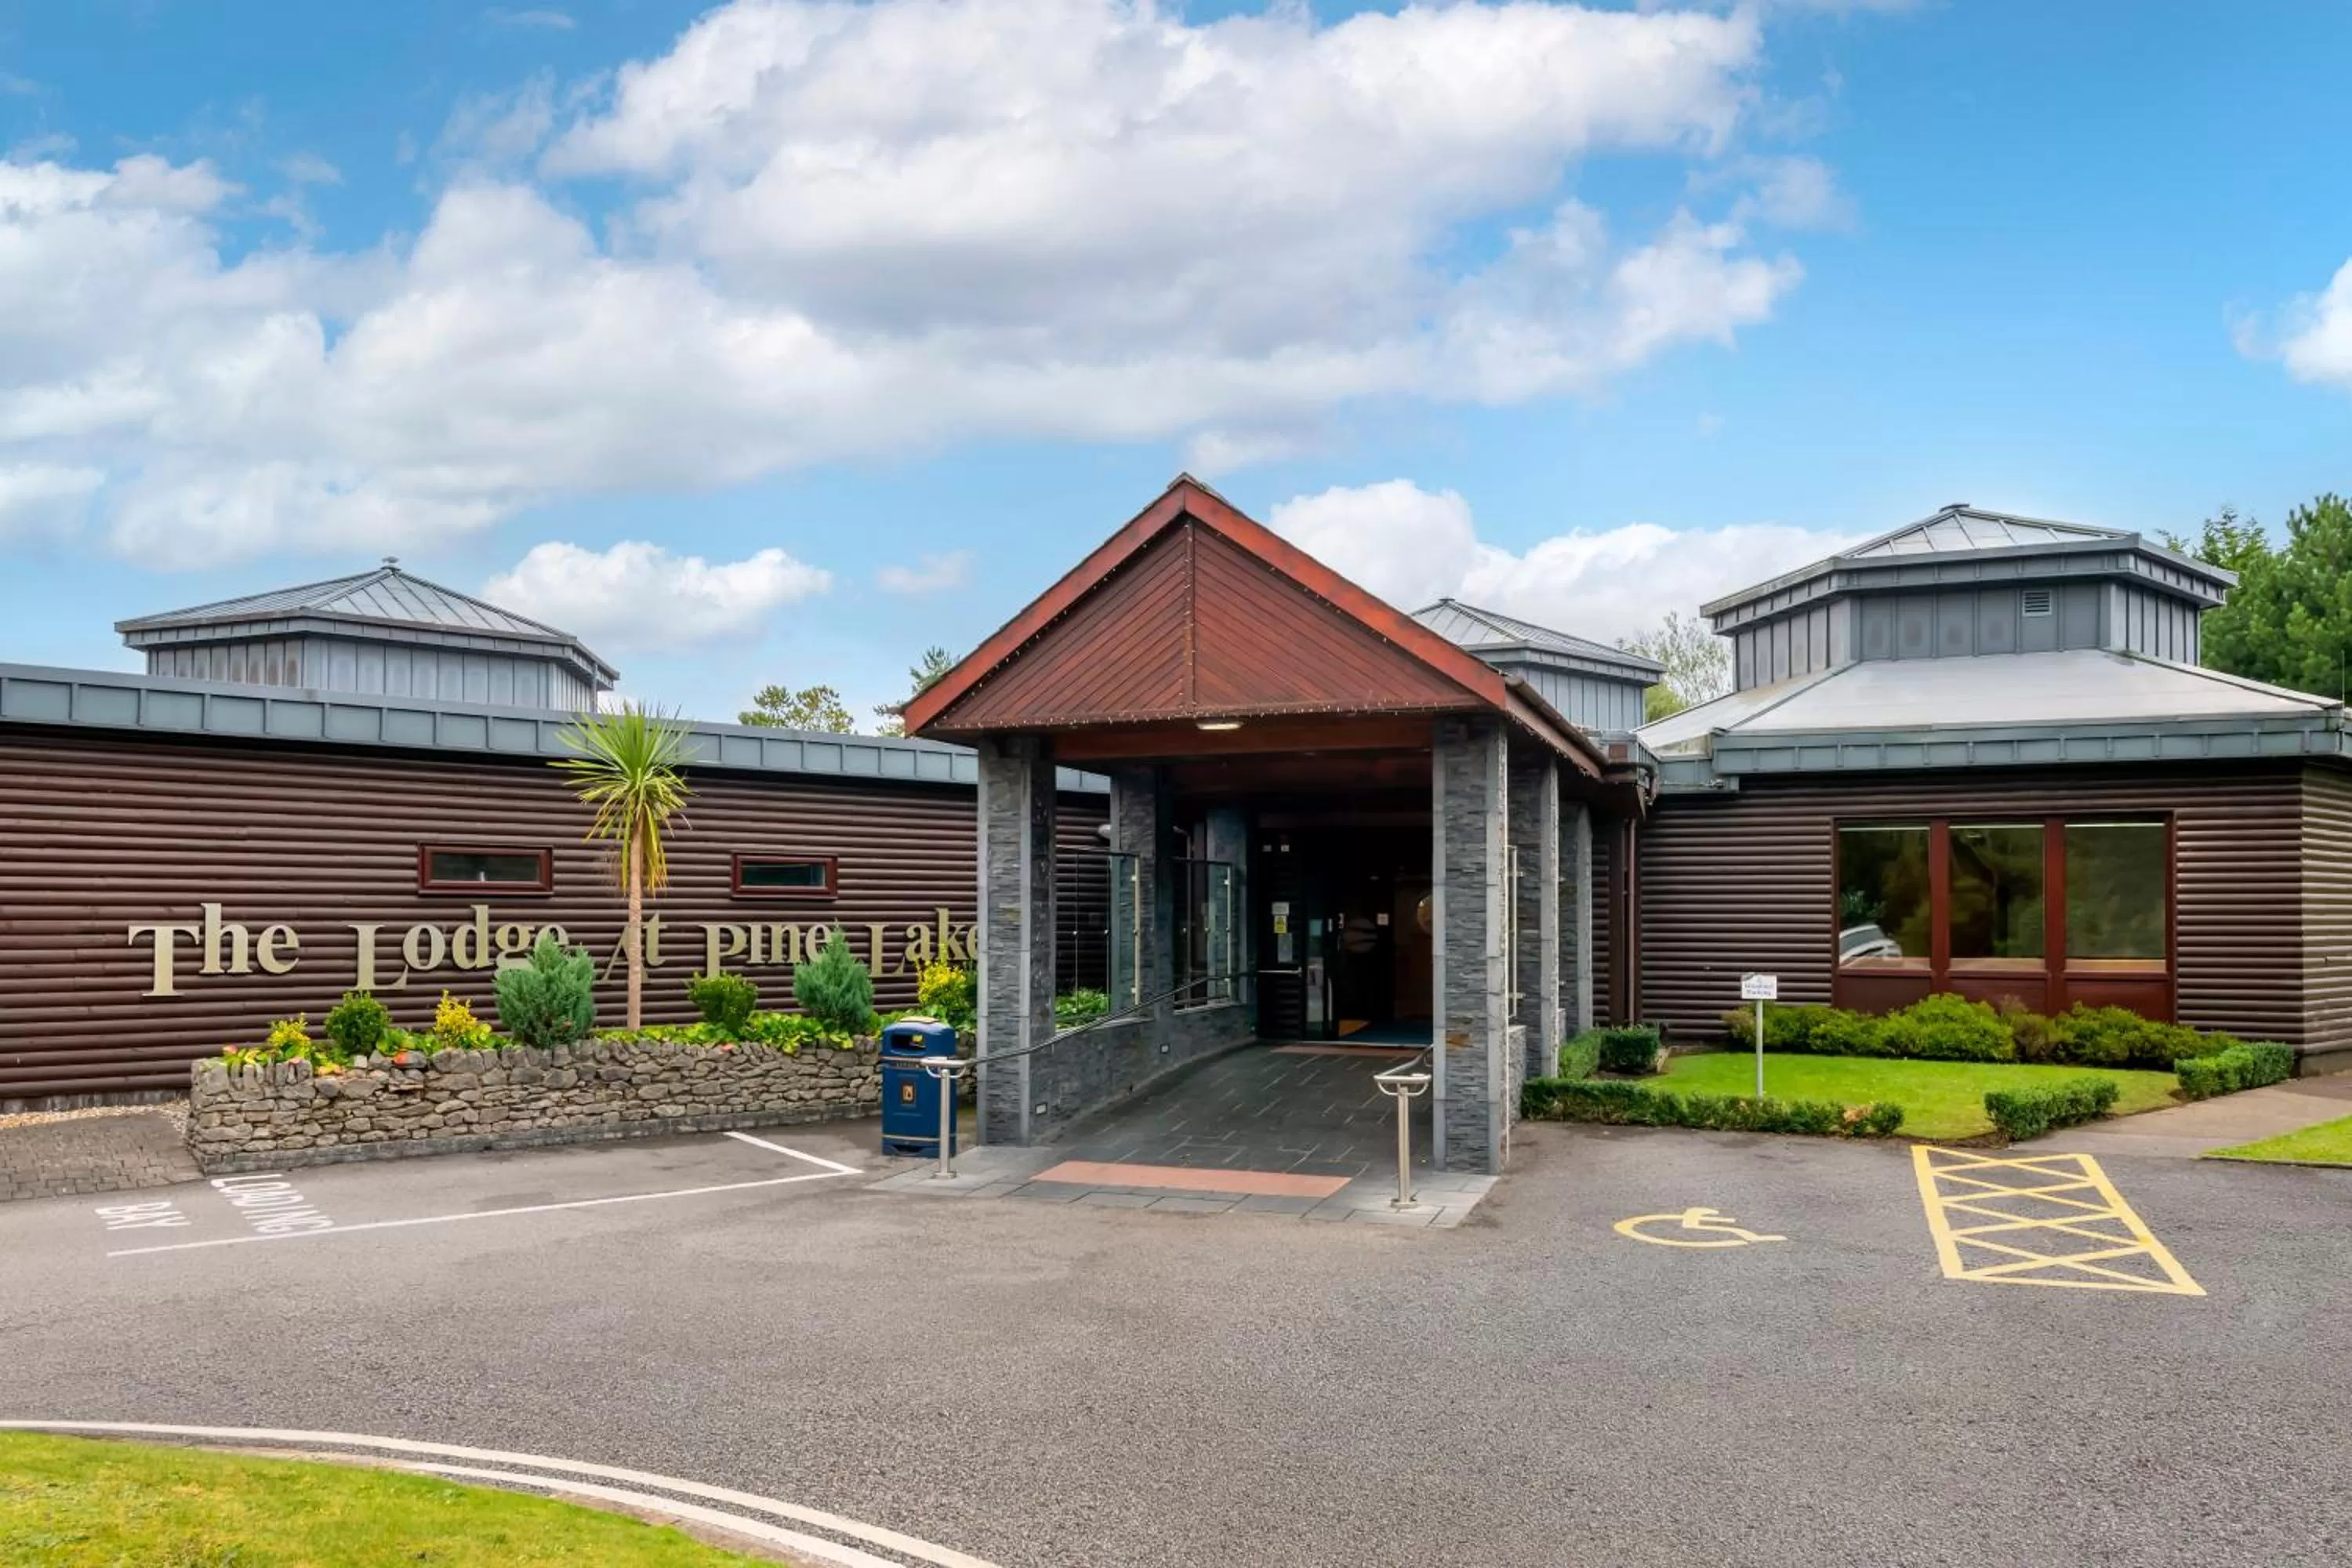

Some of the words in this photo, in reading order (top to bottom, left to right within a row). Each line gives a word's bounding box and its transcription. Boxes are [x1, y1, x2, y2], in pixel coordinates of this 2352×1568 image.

[128, 903, 300, 996] The
[699, 923, 833, 979] Pine
[94, 1200, 192, 1230] BAY
[210, 1174, 335, 1233] LOADING
